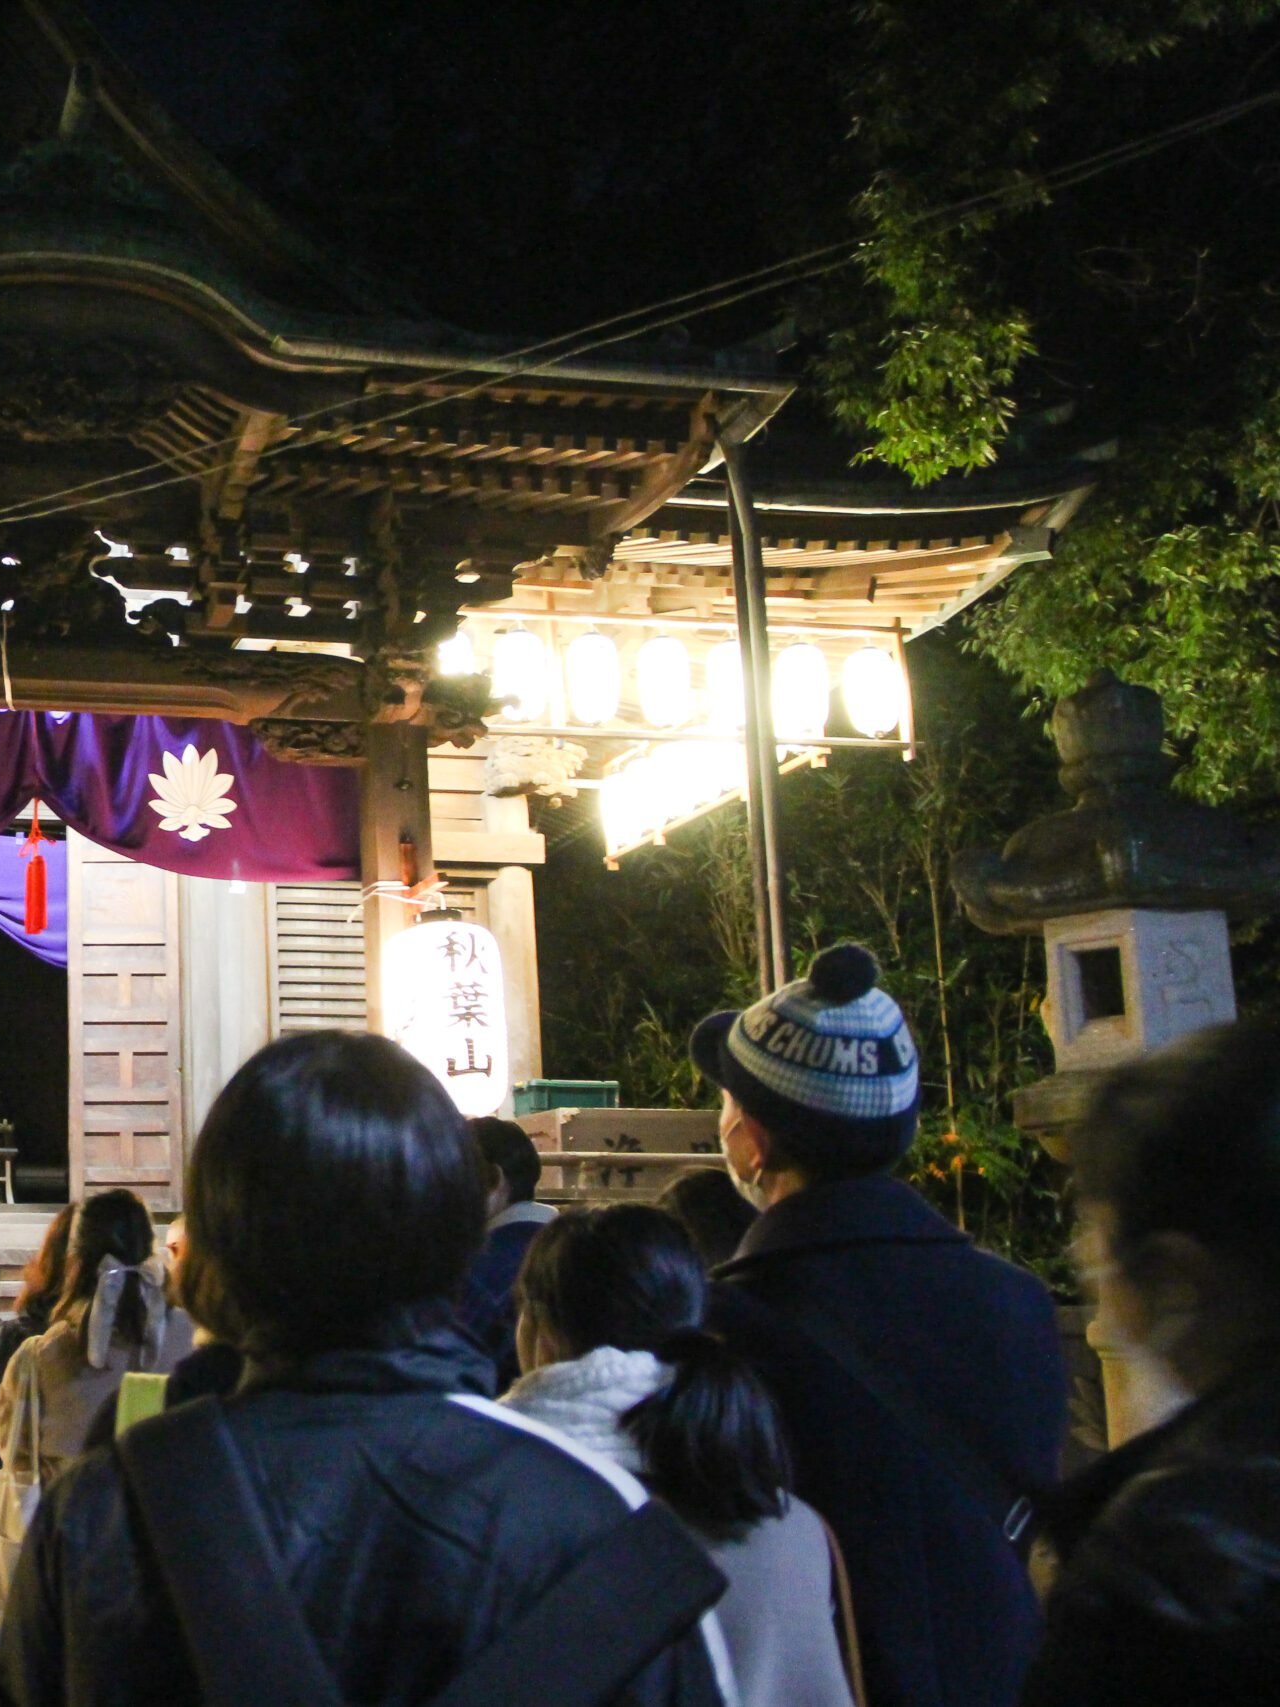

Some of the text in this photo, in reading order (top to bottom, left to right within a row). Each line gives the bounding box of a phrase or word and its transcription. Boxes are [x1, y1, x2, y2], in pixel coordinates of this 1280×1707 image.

[436, 930, 493, 1078] 秋葉山
[766, 1020, 879, 1076] CHUMS
